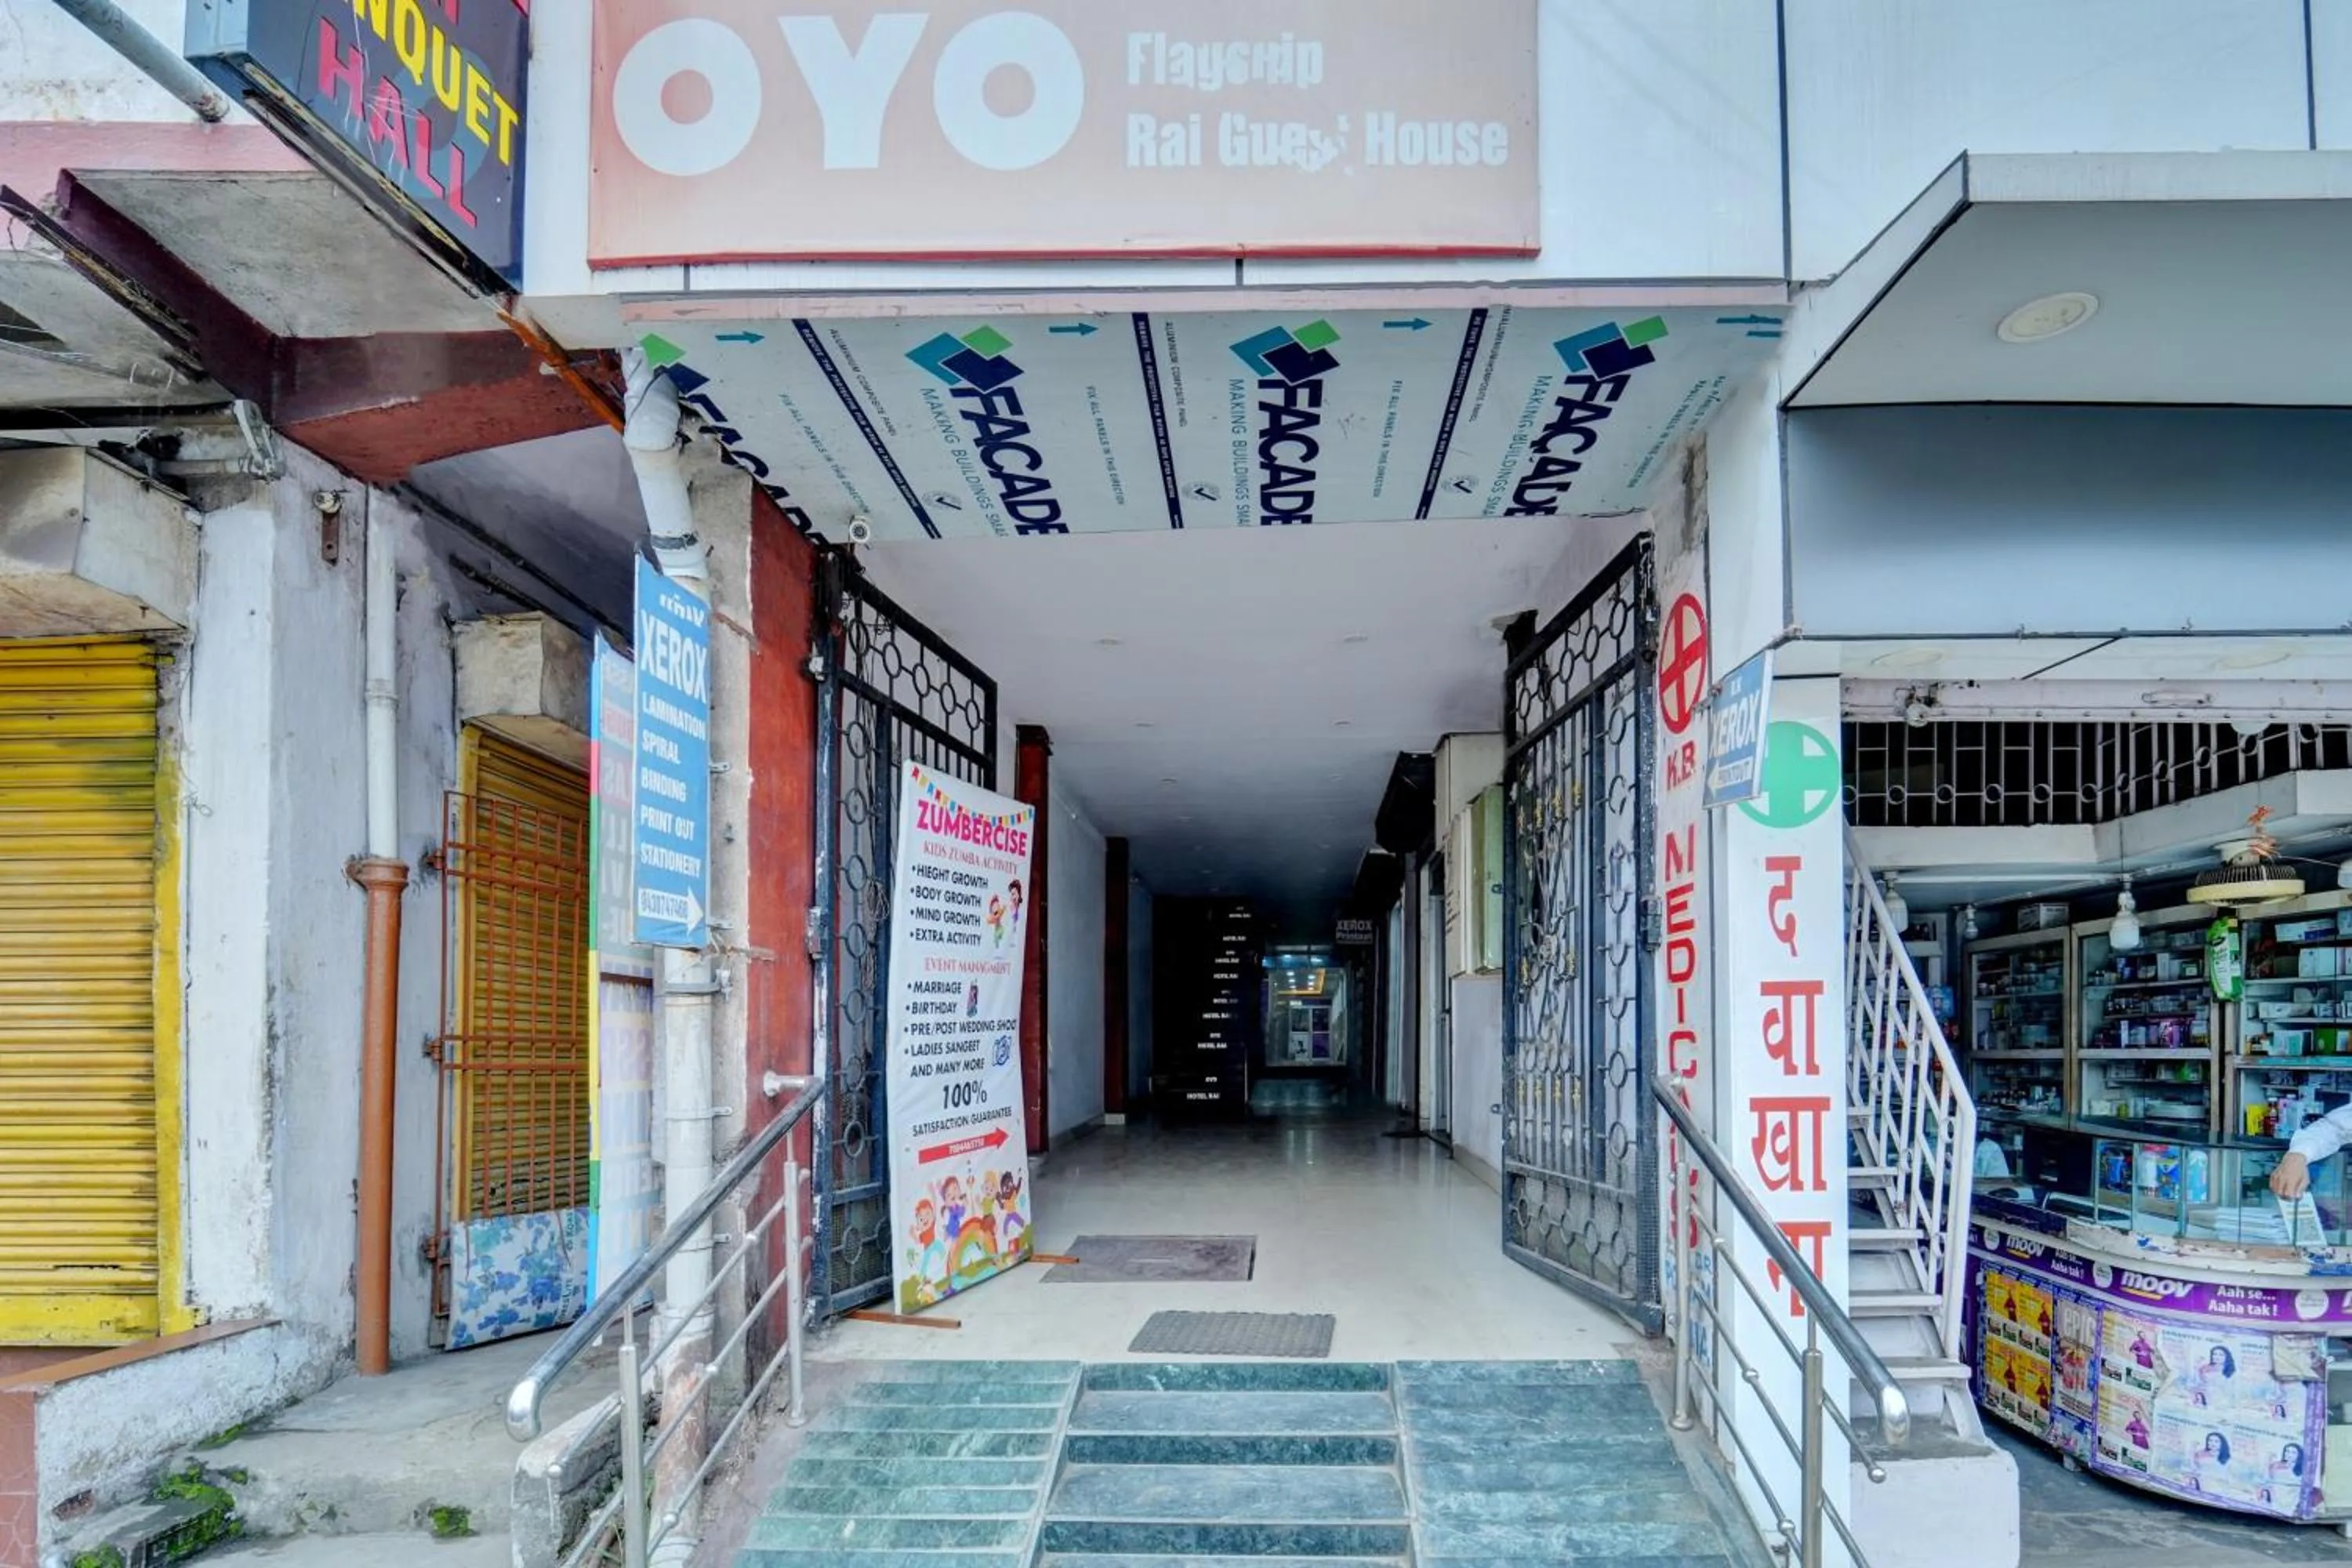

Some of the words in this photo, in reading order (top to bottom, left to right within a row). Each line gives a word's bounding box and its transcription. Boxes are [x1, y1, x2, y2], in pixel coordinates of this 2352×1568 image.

[613, 12, 1085, 176] OYO
[318, 15, 477, 227] HALL
[1127, 112, 1201, 168] Rai
[1365, 111, 1509, 168] House
[1229, 378, 1246, 434] MAKING
[1517, 375, 1552, 428] MAKING
[919, 389, 961, 442] MAKING
[951, 449, 995, 507] BUILDINGS
[1232, 440, 1250, 500] BUILDINGS
[641, 609, 707, 703] XEROX
[642, 691, 706, 741] LAMINATION
[641, 729, 681, 764] SPIRAL
[641, 767, 687, 802] BINDING
[641, 804, 673, 834] PRINT
[675, 815, 695, 841] OUT
[916, 799, 1028, 857] ZUMBERCISE
[641, 840, 702, 879] STATIONERY
[924, 840, 946, 858] KIDS
[952, 870, 989, 888] GROWTH
[915, 885, 941, 901] BODY
[944, 890, 981, 906] GROWTH
[915, 907, 941, 921] MIND
[943, 911, 981, 927] GROWTH
[915, 928, 943, 942] EXTRA
[946, 931, 981, 946] ACTIVITY
[925, 957, 956, 972] EVENT
[913, 981, 962, 994] MARRIAGE
[912, 1001, 957, 1014] BIRTHDAY
[959, 1019, 995, 1033] WEDDING
[911, 1041, 943, 1056] LADIES
[945, 1039, 981, 1054] SANGEET
[910, 1063, 933, 1078] AND
[935, 1060, 960, 1075] MANY
[962, 1058, 985, 1072] MORE
[942, 1079, 988, 1109] 100%
[913, 1116, 969, 1138] SATISFACTION
[971, 1105, 1012, 1124] GUARANTEE
[2006, 1235, 2045, 1258] moov
[2120, 1270, 2195, 1298] moov
[2216, 1285, 2245, 1299] Aah
[2248, 1287, 2276, 1301] se...
[2208, 1299, 2244, 1315] Aaha
